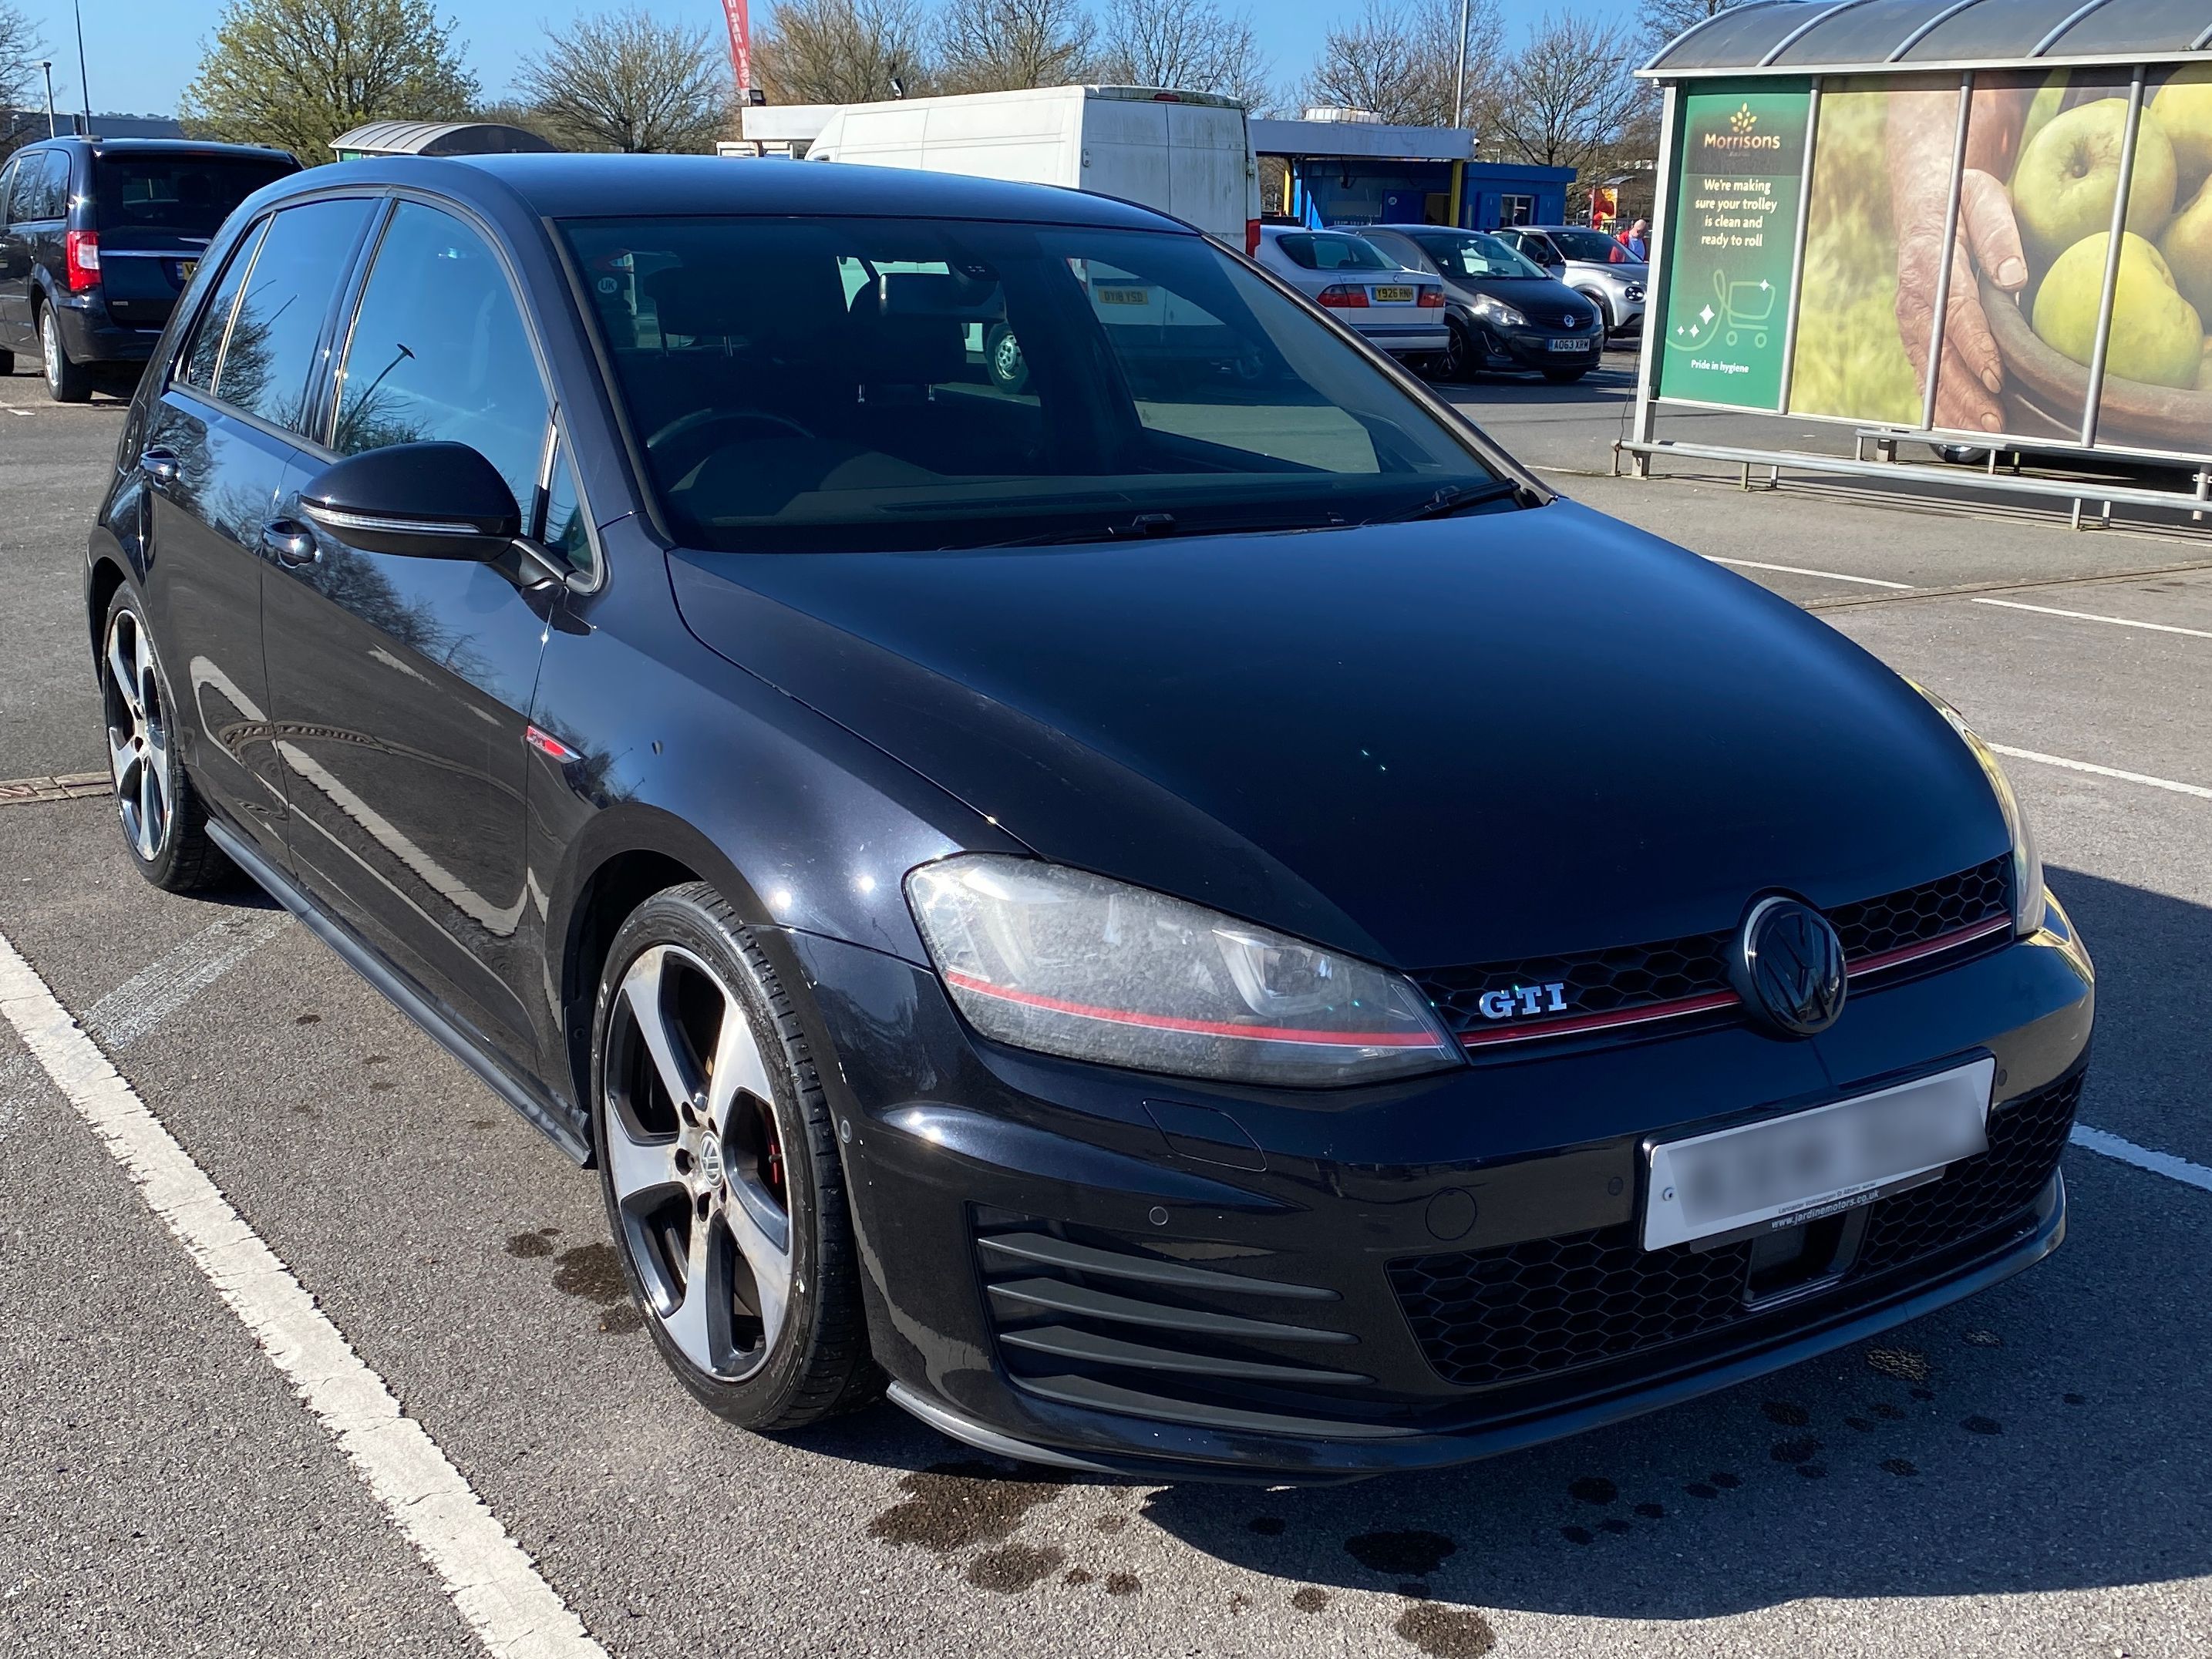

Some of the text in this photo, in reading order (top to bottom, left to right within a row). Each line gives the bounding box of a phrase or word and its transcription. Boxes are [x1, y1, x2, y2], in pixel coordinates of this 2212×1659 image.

[1704, 133, 1781, 150] Morrisons
[1704, 178, 1772, 195] We're making
[1695, 197, 1778, 214] sure your trolley
[1705, 214, 1763, 228] is clean and
[1701, 233, 1763, 248] ready to roll
[601, 279, 615, 291] UK
[1376, 288, 1399, 298] Y926
[1691, 358, 1749, 375] Pride in hygiene
[1479, 983, 1567, 1019] GTI
[1771, 1190, 1880, 1229] www.jardinemotors.co.uk
